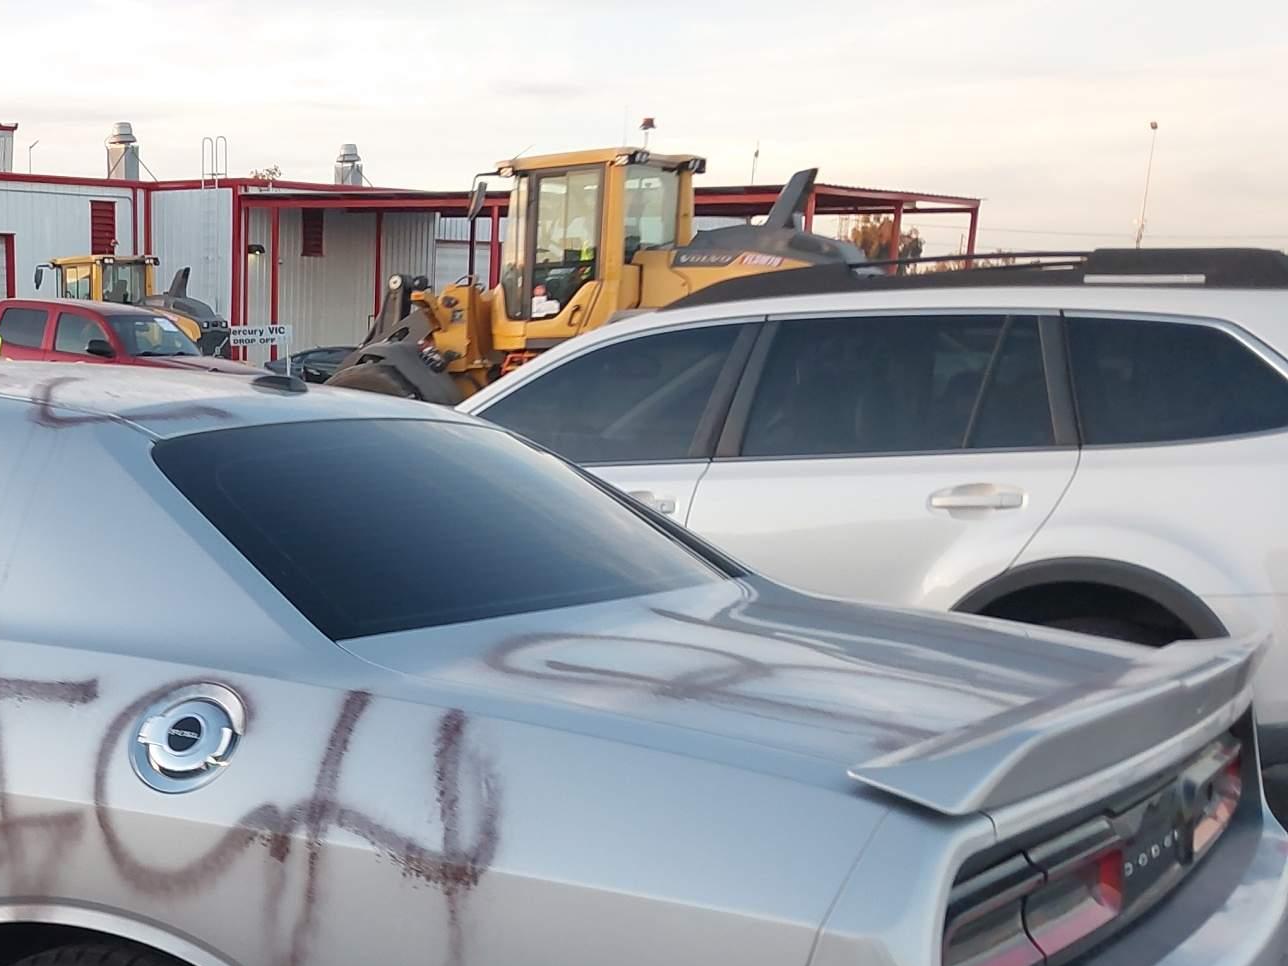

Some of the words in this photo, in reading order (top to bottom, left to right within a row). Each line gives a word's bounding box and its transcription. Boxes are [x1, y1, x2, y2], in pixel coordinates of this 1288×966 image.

[229, 327, 264, 337] ercury
[268, 326, 286, 335] VIC
[1123, 828, 1179, 878] DODG
